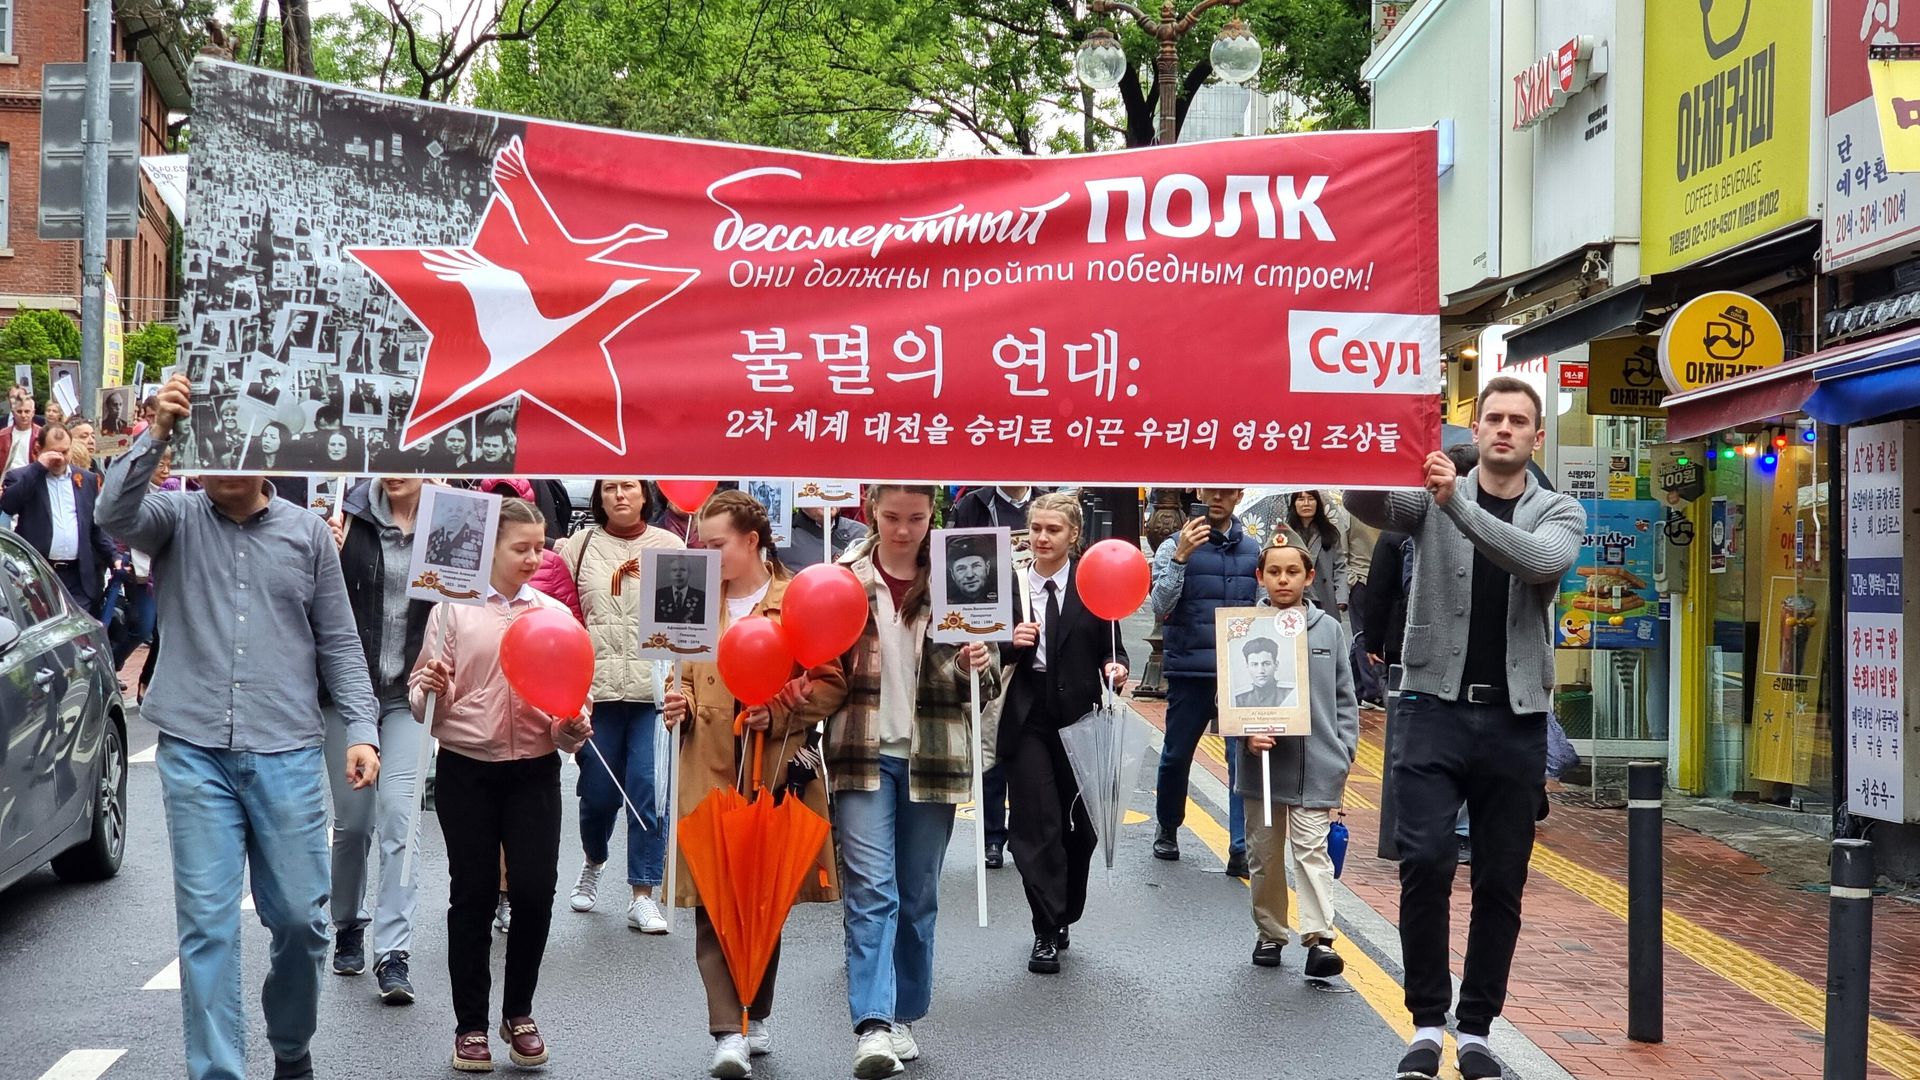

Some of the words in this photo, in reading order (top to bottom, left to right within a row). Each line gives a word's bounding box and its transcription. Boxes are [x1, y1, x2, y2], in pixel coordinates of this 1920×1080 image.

[1676, 42, 1776, 182] 아재커피
[1084, 173, 1337, 243] ПОЛК
[1685, 183, 1713, 215] COFFEE
[1713, 184, 1720, 204] &
[1721, 160, 1763, 200] BEVERAGE
[1758, 188, 1780, 221] #002
[728, 259, 796, 289] Они
[803, 259, 929, 290] должны
[942, 260, 1075, 292] пройти
[1087, 253, 1245, 286] победным
[1254, 261, 1375, 295] строем!
[731, 324, 945, 399] 불멸의
[992, 327, 1141, 403] 연대:
[1309, 327, 1421, 388] Сеул
[725, 407, 778, 441] 2차
[788, 408, 850, 444] 세계
[864, 411, 955, 445] 대전을
[964, 414, 1054, 447] 승리로
[1066, 416, 1125, 448] 이끈
[1134, 416, 1220, 450] 우리의
[1232, 419, 1312, 451] 영웅인
[1321, 421, 1401, 454] 조상들
[1851, 573, 1868, 596] 건강은
[1886, 573, 1900, 596] 근원
[1852, 626, 1898, 660] 장터국밥
[1852, 664, 1898, 699] 육회비빔밥
